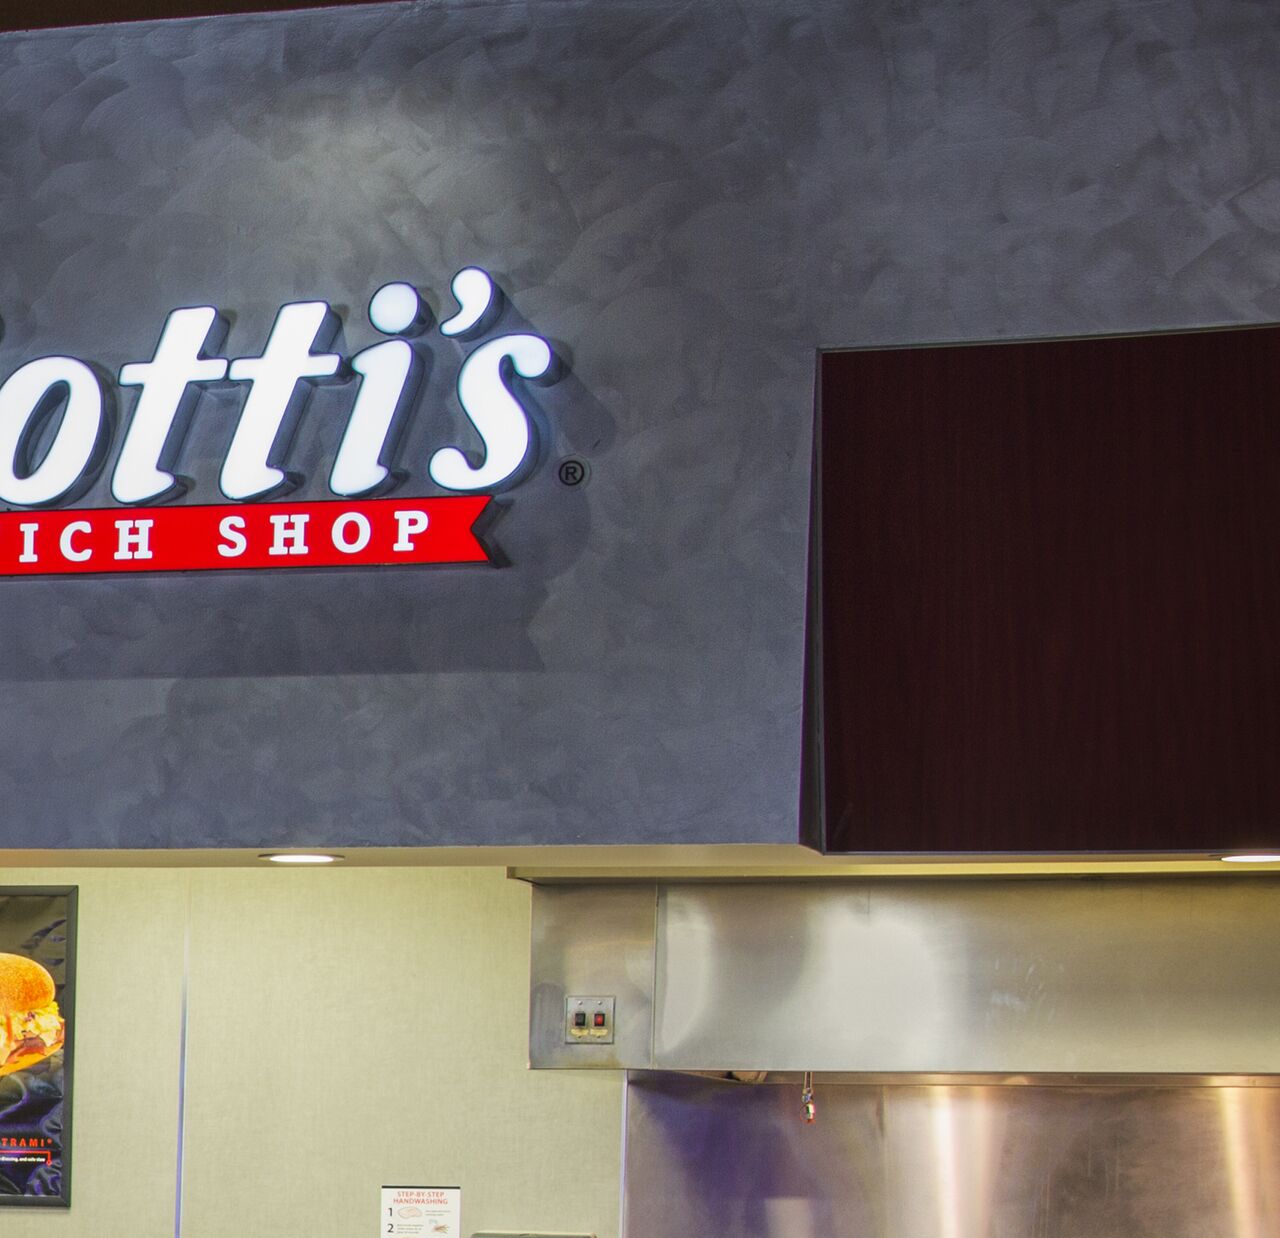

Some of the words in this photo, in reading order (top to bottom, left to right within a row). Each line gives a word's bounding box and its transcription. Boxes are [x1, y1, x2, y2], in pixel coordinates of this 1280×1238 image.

[216, 508, 433, 559] SHOP
[392, 1198, 449, 1206] HANDWASHING
[387, 1207, 394, 1217] 1
[386, 1223, 395, 1233] 2
